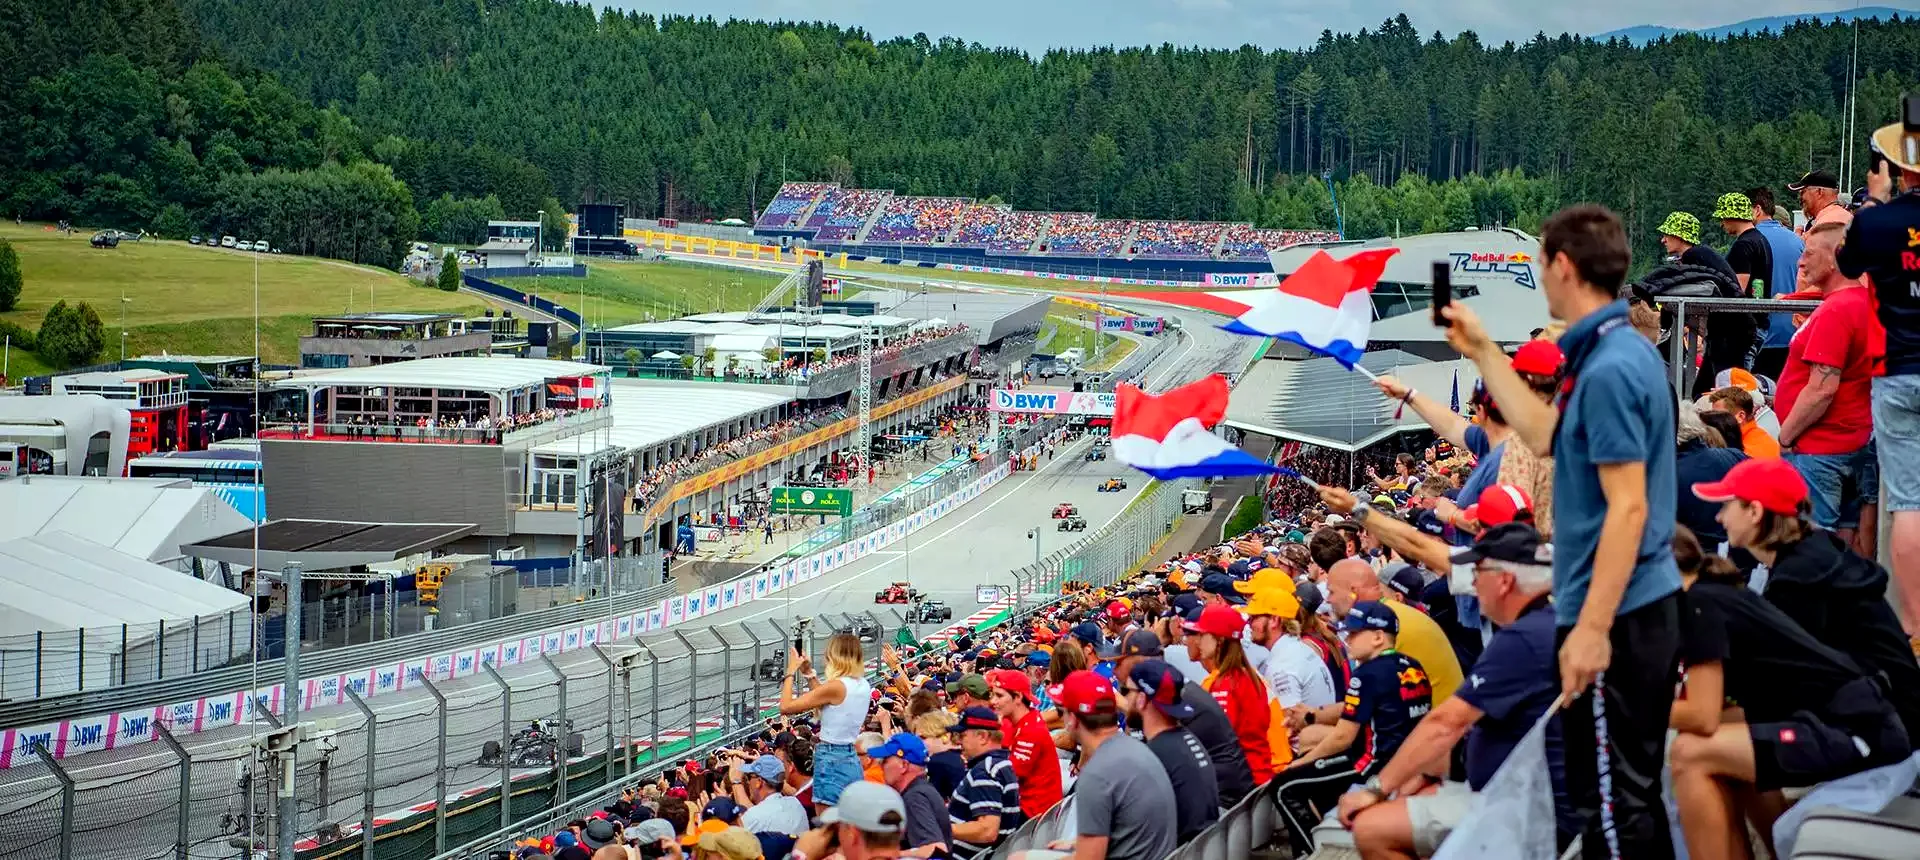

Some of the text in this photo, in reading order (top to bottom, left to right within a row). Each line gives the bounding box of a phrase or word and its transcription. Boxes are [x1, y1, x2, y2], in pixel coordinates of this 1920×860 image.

[1471, 253, 1504, 262] Red Bull
[1449, 253, 1536, 290] Ring
[1223, 276, 1248, 284] BWT
[1107, 320, 1126, 328] BWT
[1015, 394, 1057, 409] BWT
[174, 703, 193, 715] CHANGE
[214, 701, 232, 721] BWT
[130, 717, 149, 738] BWT
[177, 715, 193, 725] WORLD
[81, 724, 102, 746] BWT
[29, 732, 52, 755] BWT
